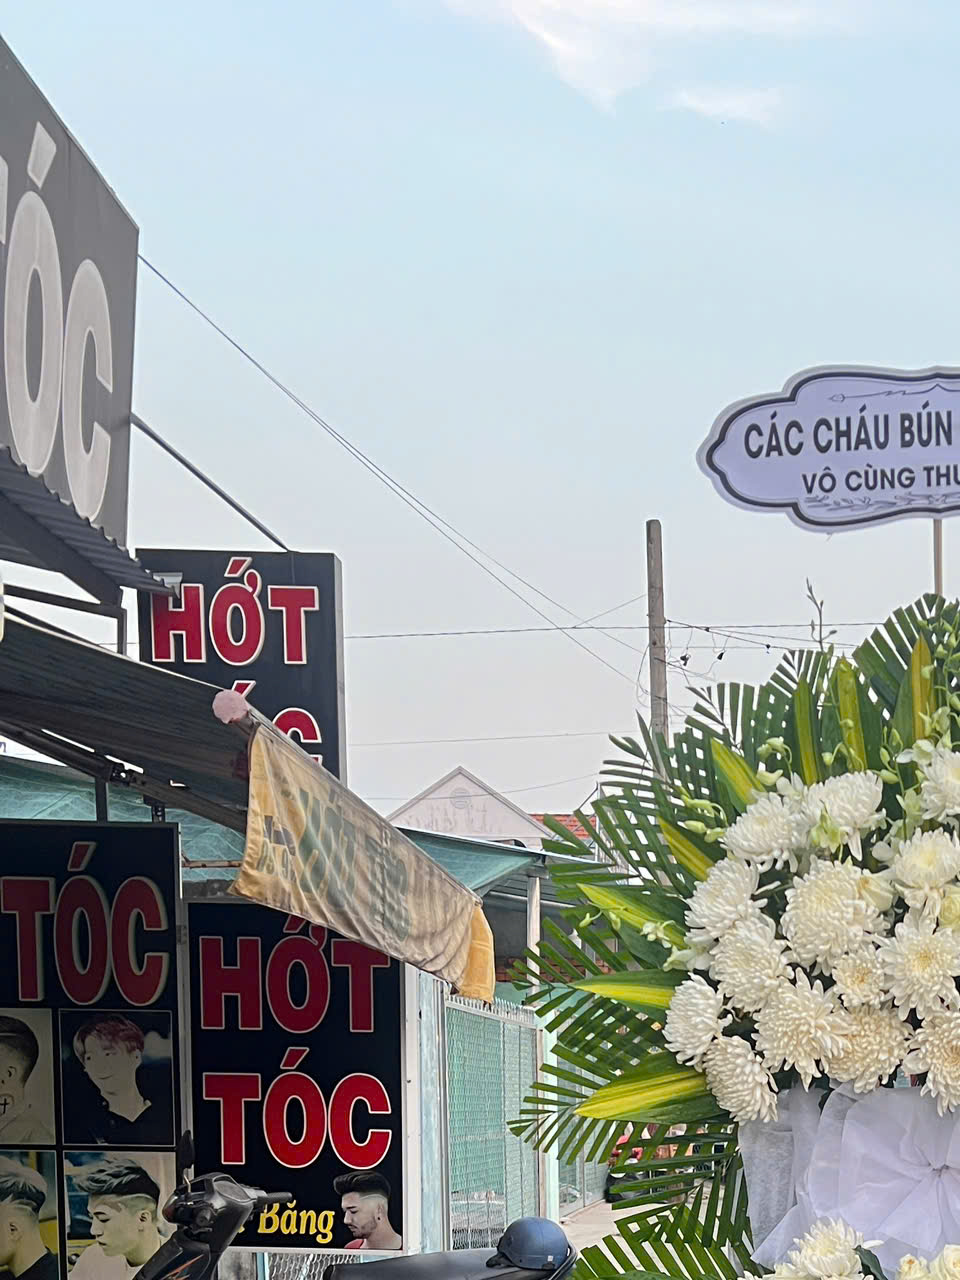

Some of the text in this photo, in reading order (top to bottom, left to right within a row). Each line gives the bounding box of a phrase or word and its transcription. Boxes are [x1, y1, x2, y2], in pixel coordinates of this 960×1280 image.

[0, 120, 114, 523] ÓC
[743, 410, 804, 459] CÁC
[813, 404, 890, 454] CHÁU
[900, 400, 952, 448] BÚN
[802, 466, 836, 494] VÔ
[845, 461, 915, 491] CÙNG
[150, 557, 318, 666] HỚT
[1, 842, 169, 1006] TÓC
[200, 912, 392, 1034] HỚT
[203, 1046, 392, 1169] TÓC
[257, 1199, 335, 1244] Băng
